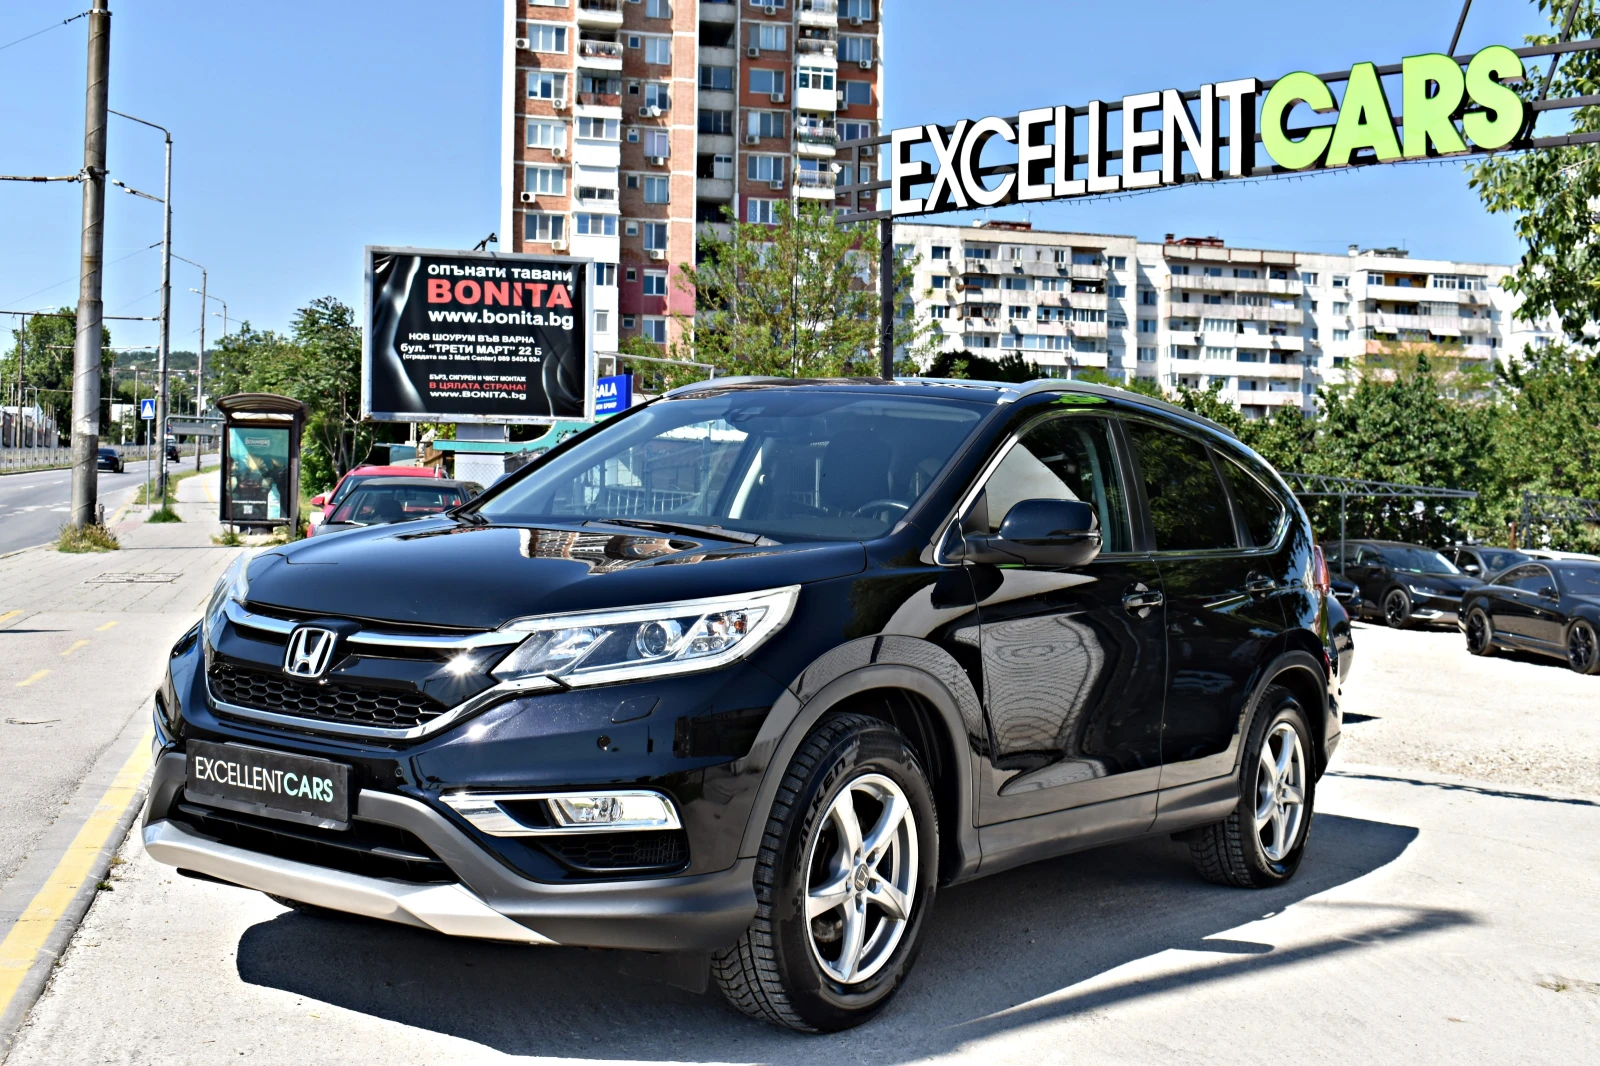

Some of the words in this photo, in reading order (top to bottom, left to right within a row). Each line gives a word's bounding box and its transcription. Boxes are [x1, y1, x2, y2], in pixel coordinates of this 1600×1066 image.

[428, 264, 506, 278] опънати
[511, 268, 572, 281] тавани
[427, 278, 573, 309] BONITA
[428, 309, 574, 330] www.bonita.bg
[408, 332, 430, 341] НОВ
[432, 333, 475, 342] ШОУРУМ
[477, 334, 500, 343] ВЪВ
[502, 335, 535, 344] ВАРНА
[400, 343, 426, 354] бул.
[518, 346, 532, 356] 22
[439, 382, 481, 390] ЦЯЛАТА
[429, 391, 527, 400] www.BONITA.bg
